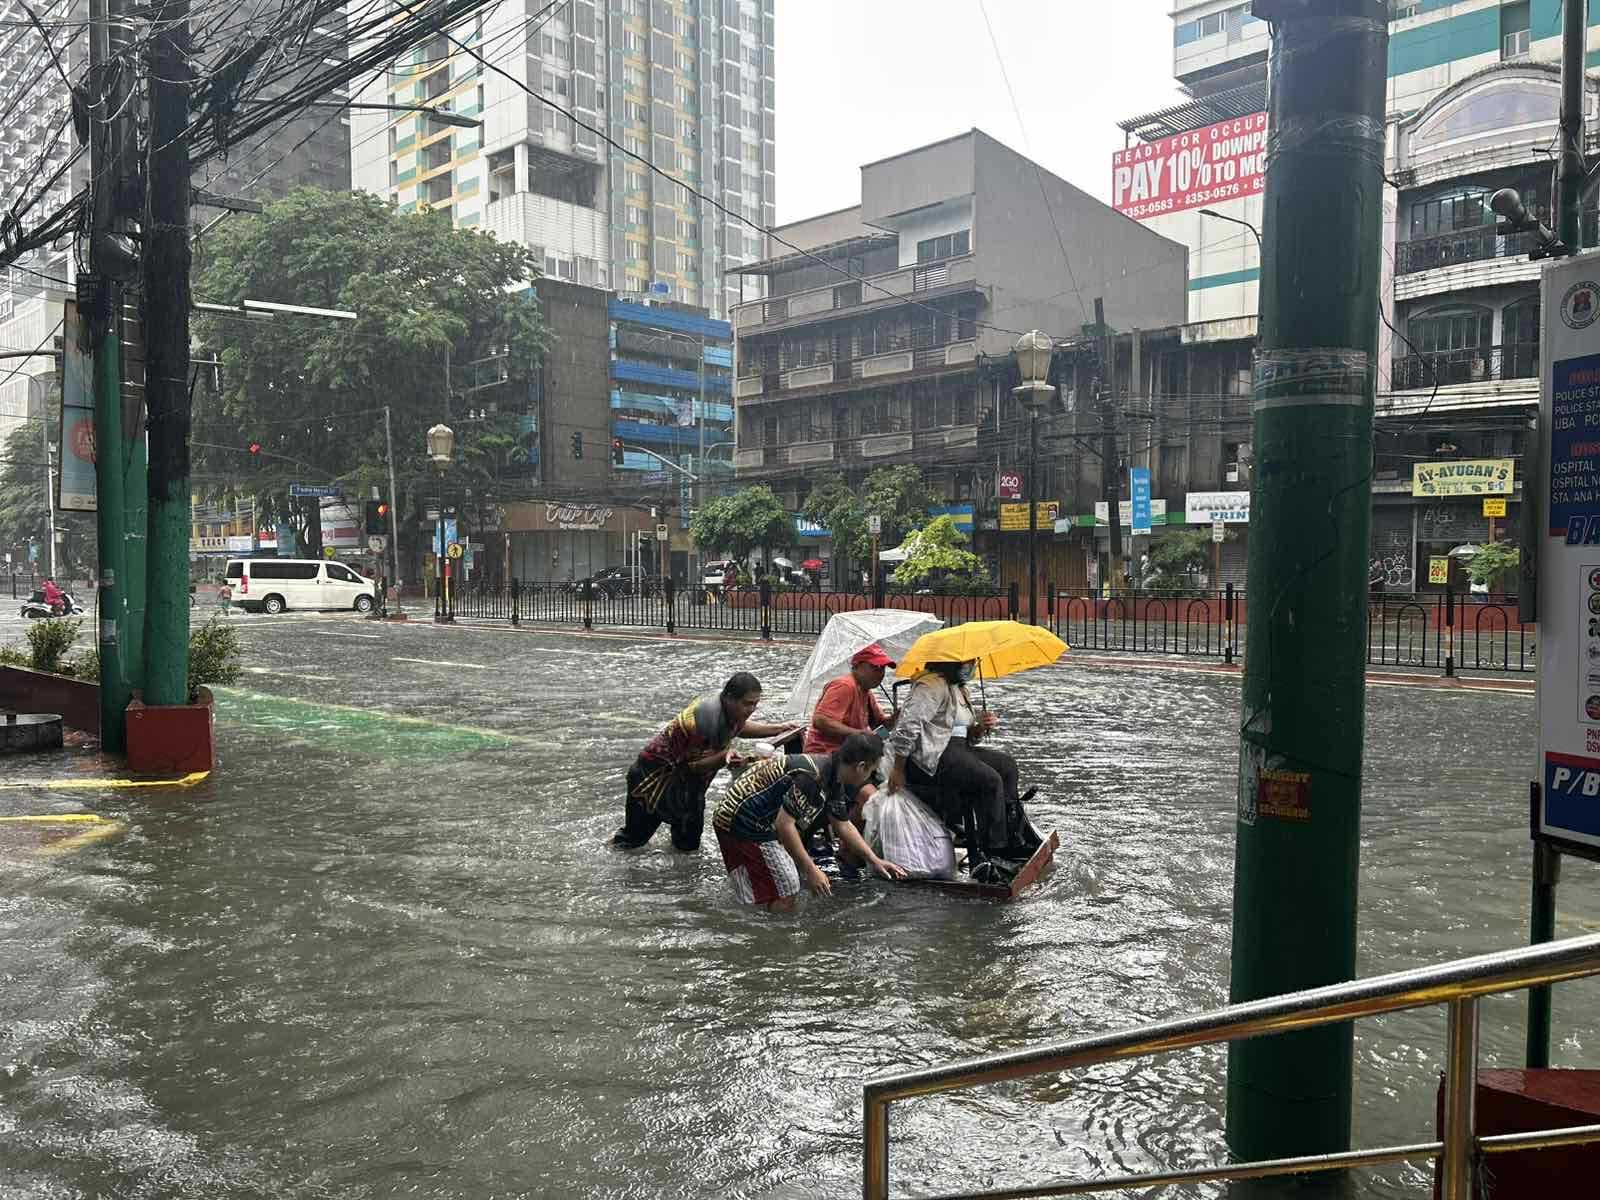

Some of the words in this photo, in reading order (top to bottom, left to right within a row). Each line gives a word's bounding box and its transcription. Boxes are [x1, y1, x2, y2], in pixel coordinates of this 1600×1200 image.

[1114, 143, 1162, 165] READY
[1171, 133, 1200, 150] FOR
[1115, 156, 1165, 206] PAY
[1168, 144, 1211, 193] 10%
[1213, 160, 1236, 184] TO
[1555, 388, 1586, 401] POLICE
[1554, 402, 1584, 415] POLICE
[1555, 417, 1576, 430] UBA
[1553, 459, 1596, 474] OSPITAL
[1000, 475, 1018, 487] 2GO
[1552, 475, 1589, 489] OSPITAL
[1574, 490, 1593, 502] ANA
[1552, 767, 1600, 797] P/B
